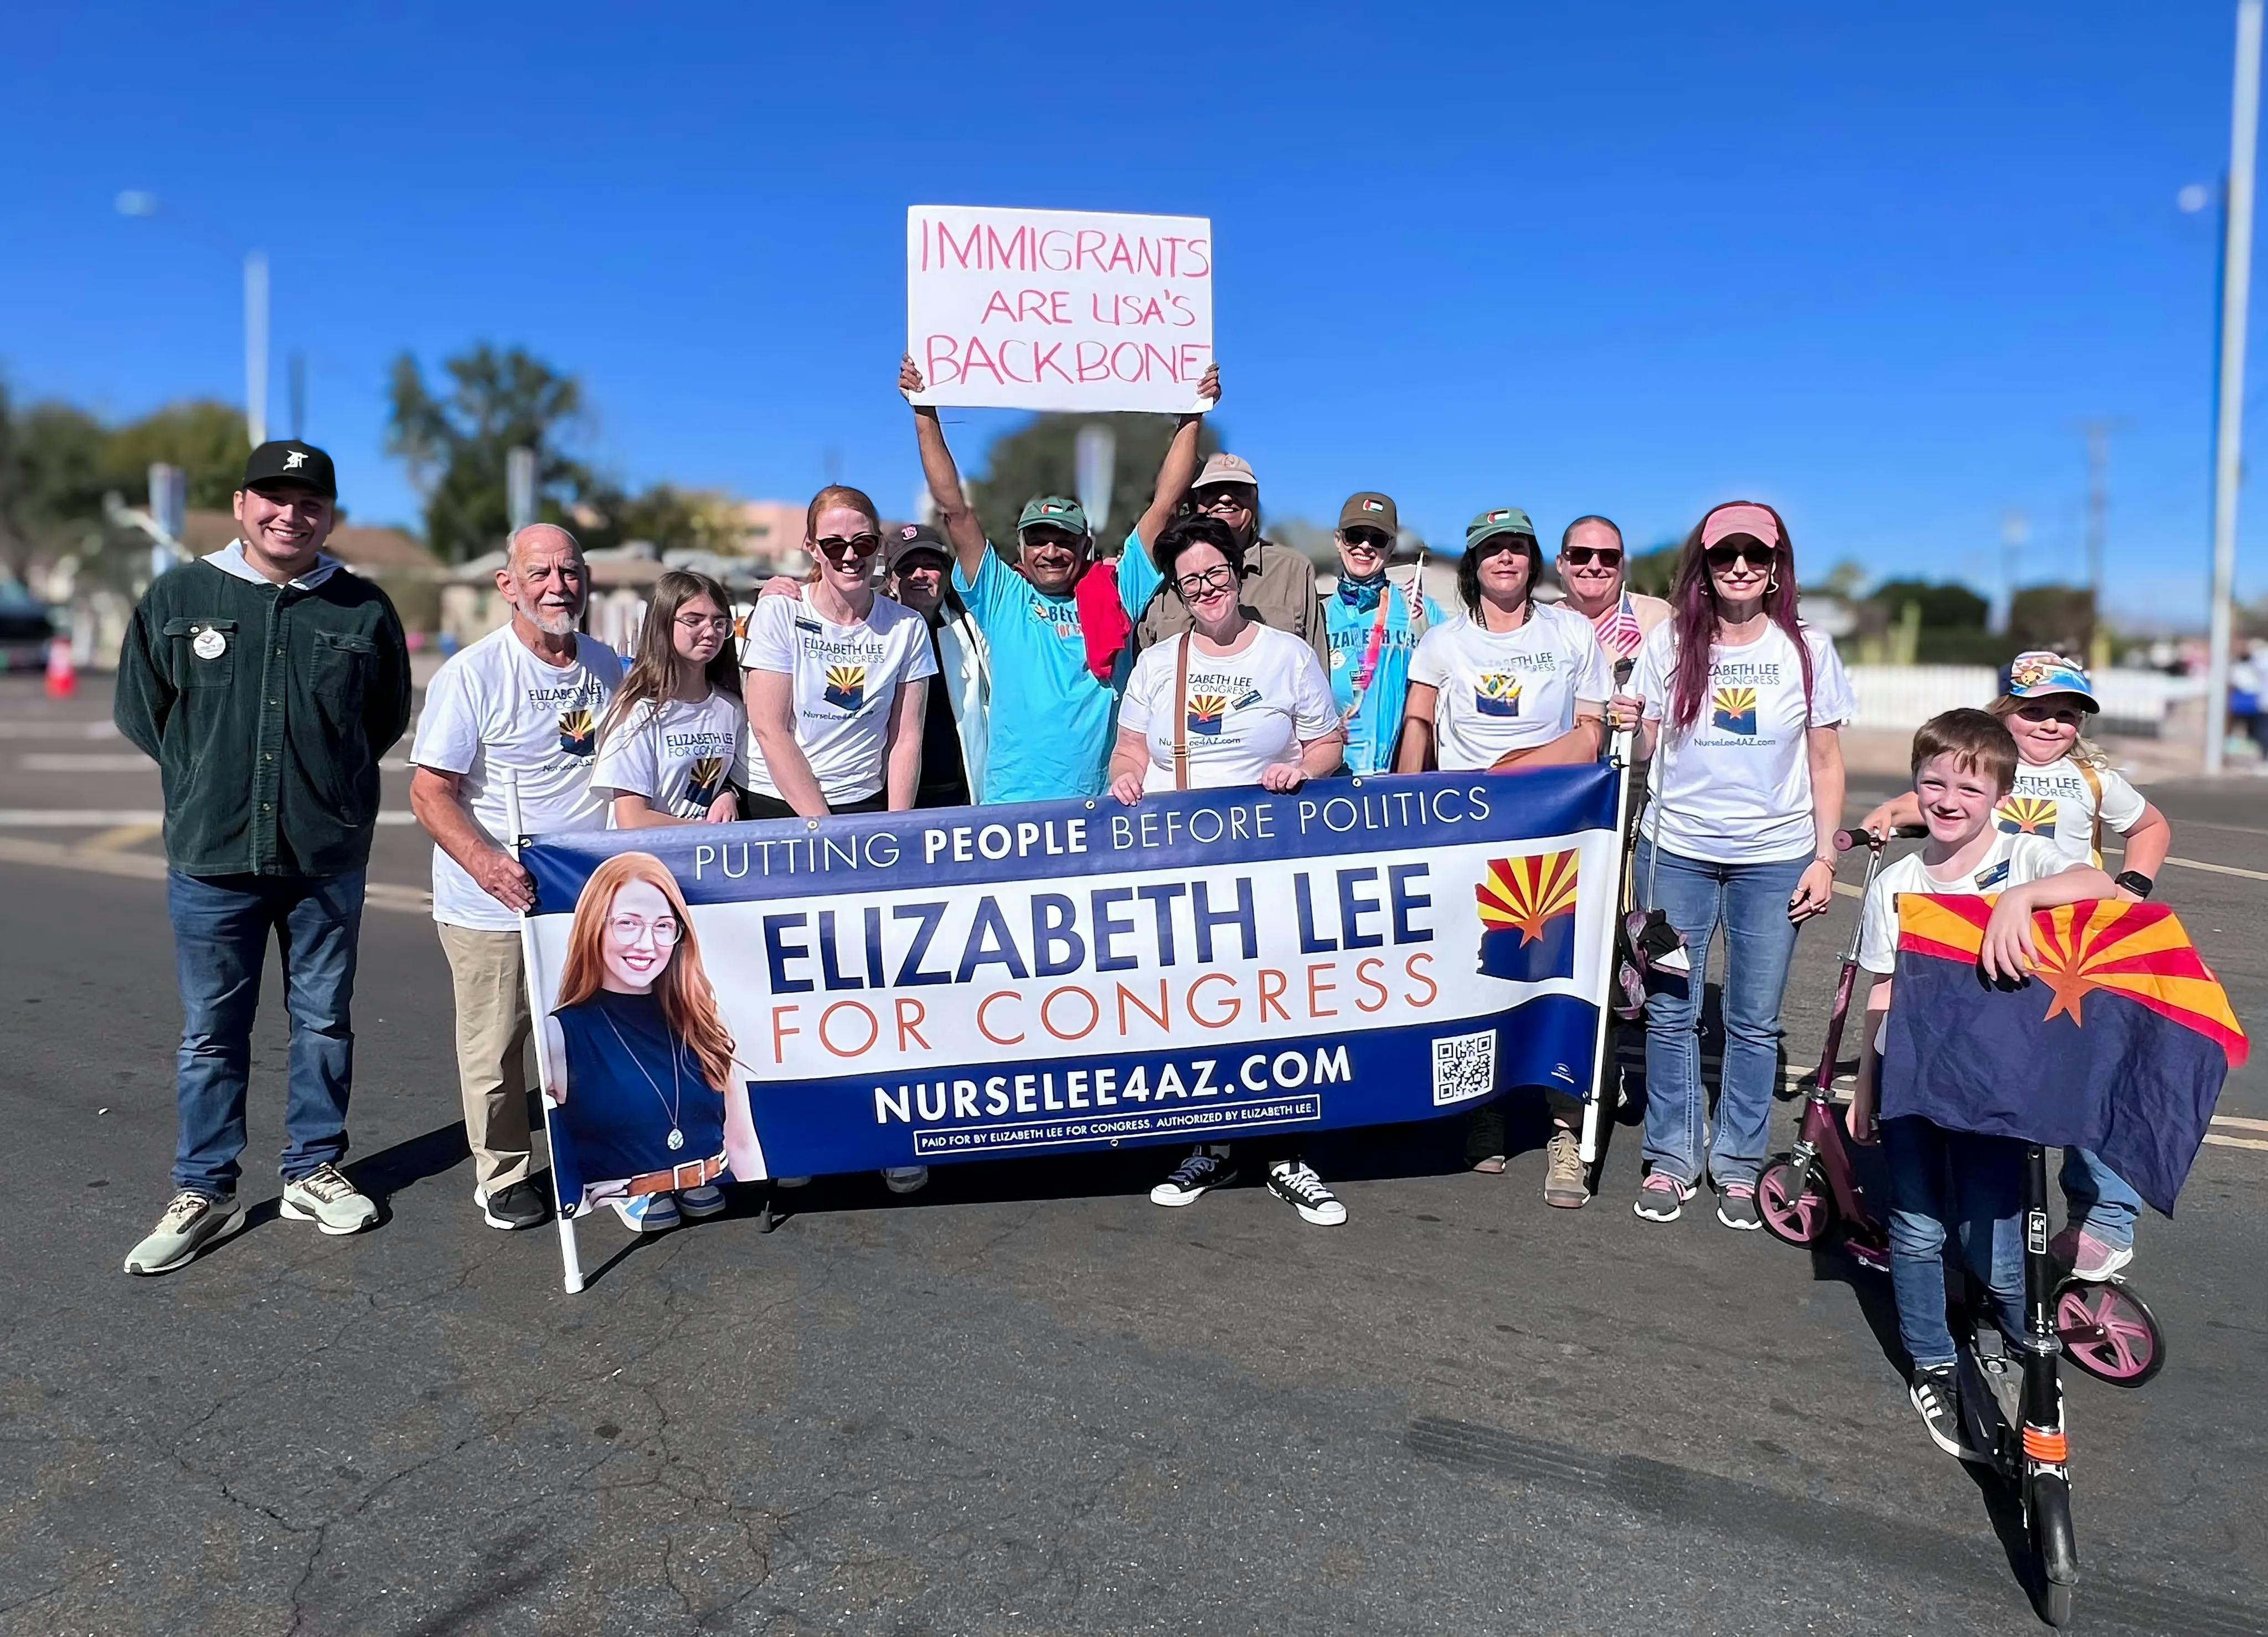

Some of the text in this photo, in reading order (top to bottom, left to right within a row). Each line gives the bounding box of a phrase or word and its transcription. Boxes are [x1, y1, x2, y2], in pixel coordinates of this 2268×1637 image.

[922, 219, 1209, 277] IMMIGRANTS
[981, 289, 1195, 326] ARE USA'S
[926, 335, 1210, 386] BACKBONE
[805, 637, 884, 655] ELIZABETH LEE
[804, 650, 885, 664] FOR CONGRESS
[1535, 652, 1553, 663] LEE
[1708, 663, 1779, 676] ZABETH LEE
[1188, 673, 1252, 687] ZABETH LEE
[1714, 676, 1780, 685] CONGRESS
[667, 733, 720, 747] ELIZABETH
[668, 745, 734, 758] FOR CONGRE
[2055, 778, 2081, 790] LEE
[2012, 785, 2083, 800] ONGRESS
[695, 786, 1491, 880] PUTTING PEOPLE BEFORE POLITICS
[762, 862, 1434, 995] ELIZABETH LEE
[772, 953, 1438, 1063] FOR CONGRESS
[874, 1045, 1352, 1124] NURSELEE4AZ.COM
[922, 1137, 946, 1148] PAID
[949, 1135, 971, 1145] FOR
[974, 1134, 987, 1144] BY
[990, 1129, 1043, 1142] ELIZABETH
[1047, 1127, 1063, 1137] LEE
[1066, 1124, 1087, 1135] FOR
[1156, 1113, 1223, 1128] AUTHORIZED
[1225, 1110, 1239, 1121] BY
[1241, 1104, 1293, 1119] ELIZABETH
